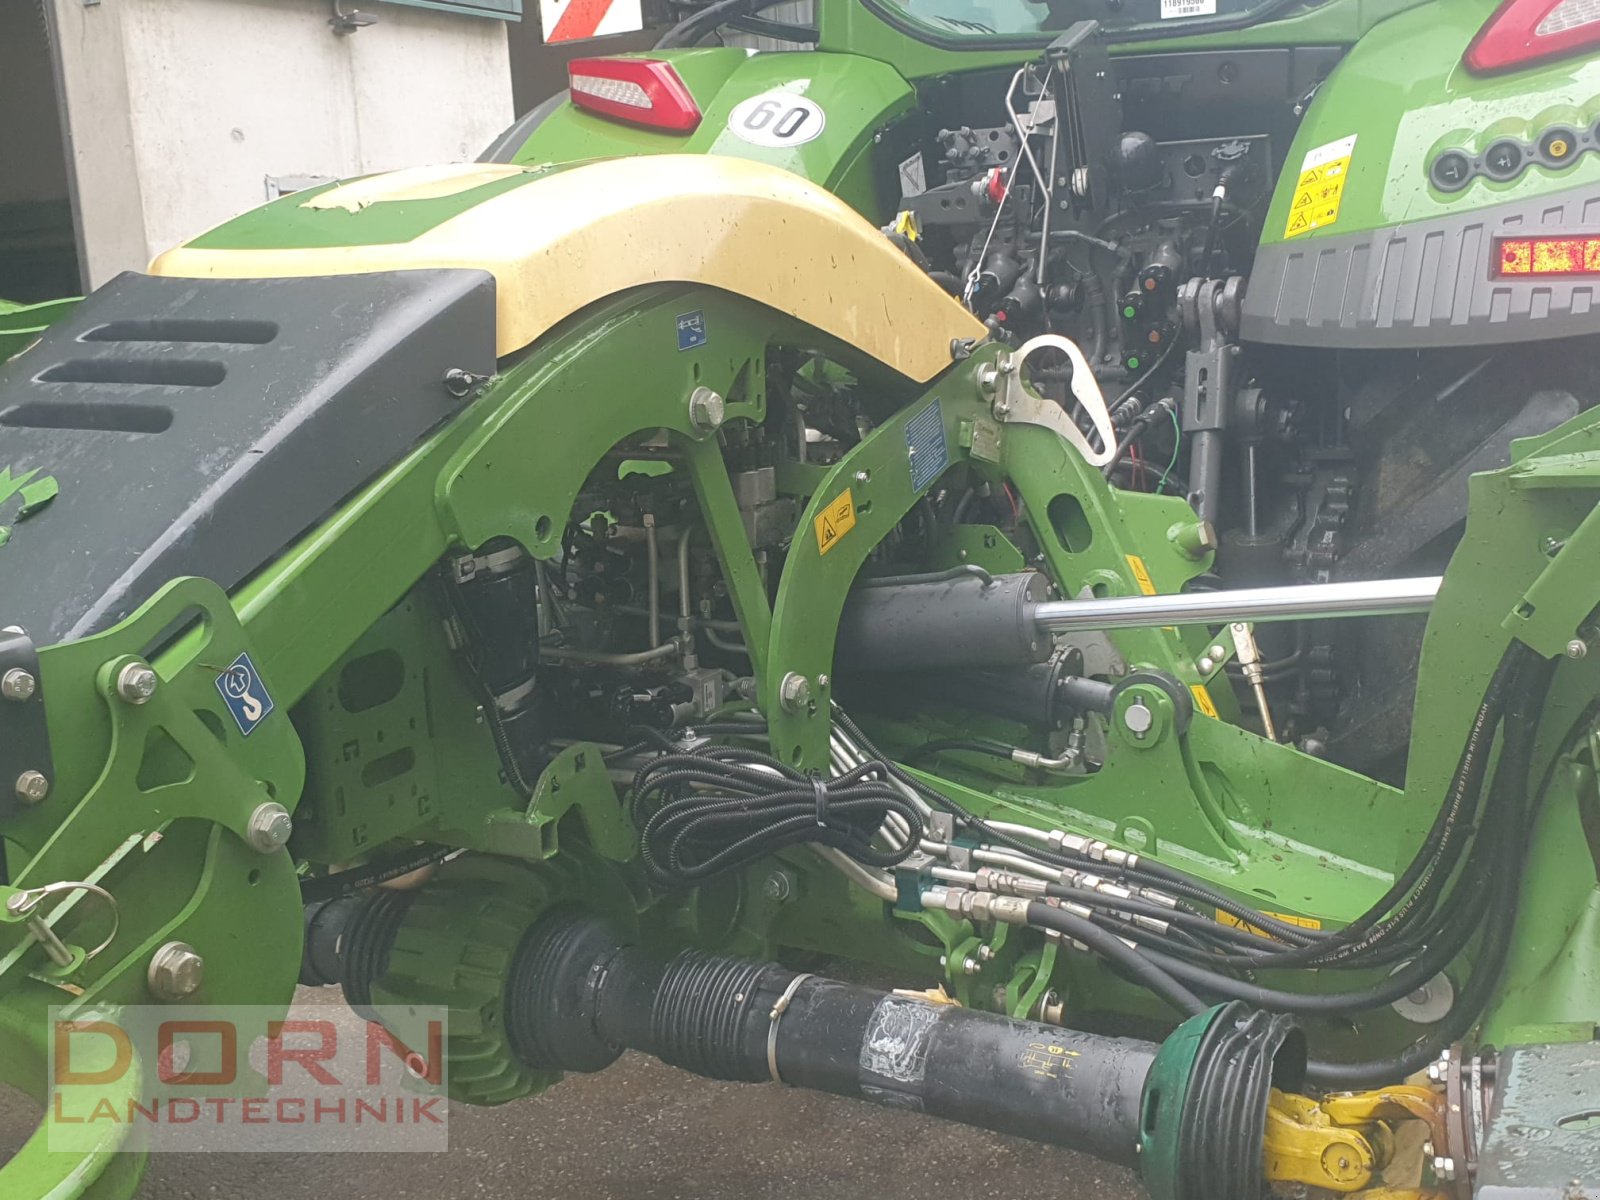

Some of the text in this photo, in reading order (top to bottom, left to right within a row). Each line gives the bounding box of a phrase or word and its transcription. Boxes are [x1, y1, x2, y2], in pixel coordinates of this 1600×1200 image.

[743, 100, 810, 138] 60
[1468, 703, 1488, 752] HYDRAULIK
[1457, 753, 1473, 792] MUELLER
[1399, 901, 1413, 918] PLUS
[1352, 942, 1368, 953] MAX
